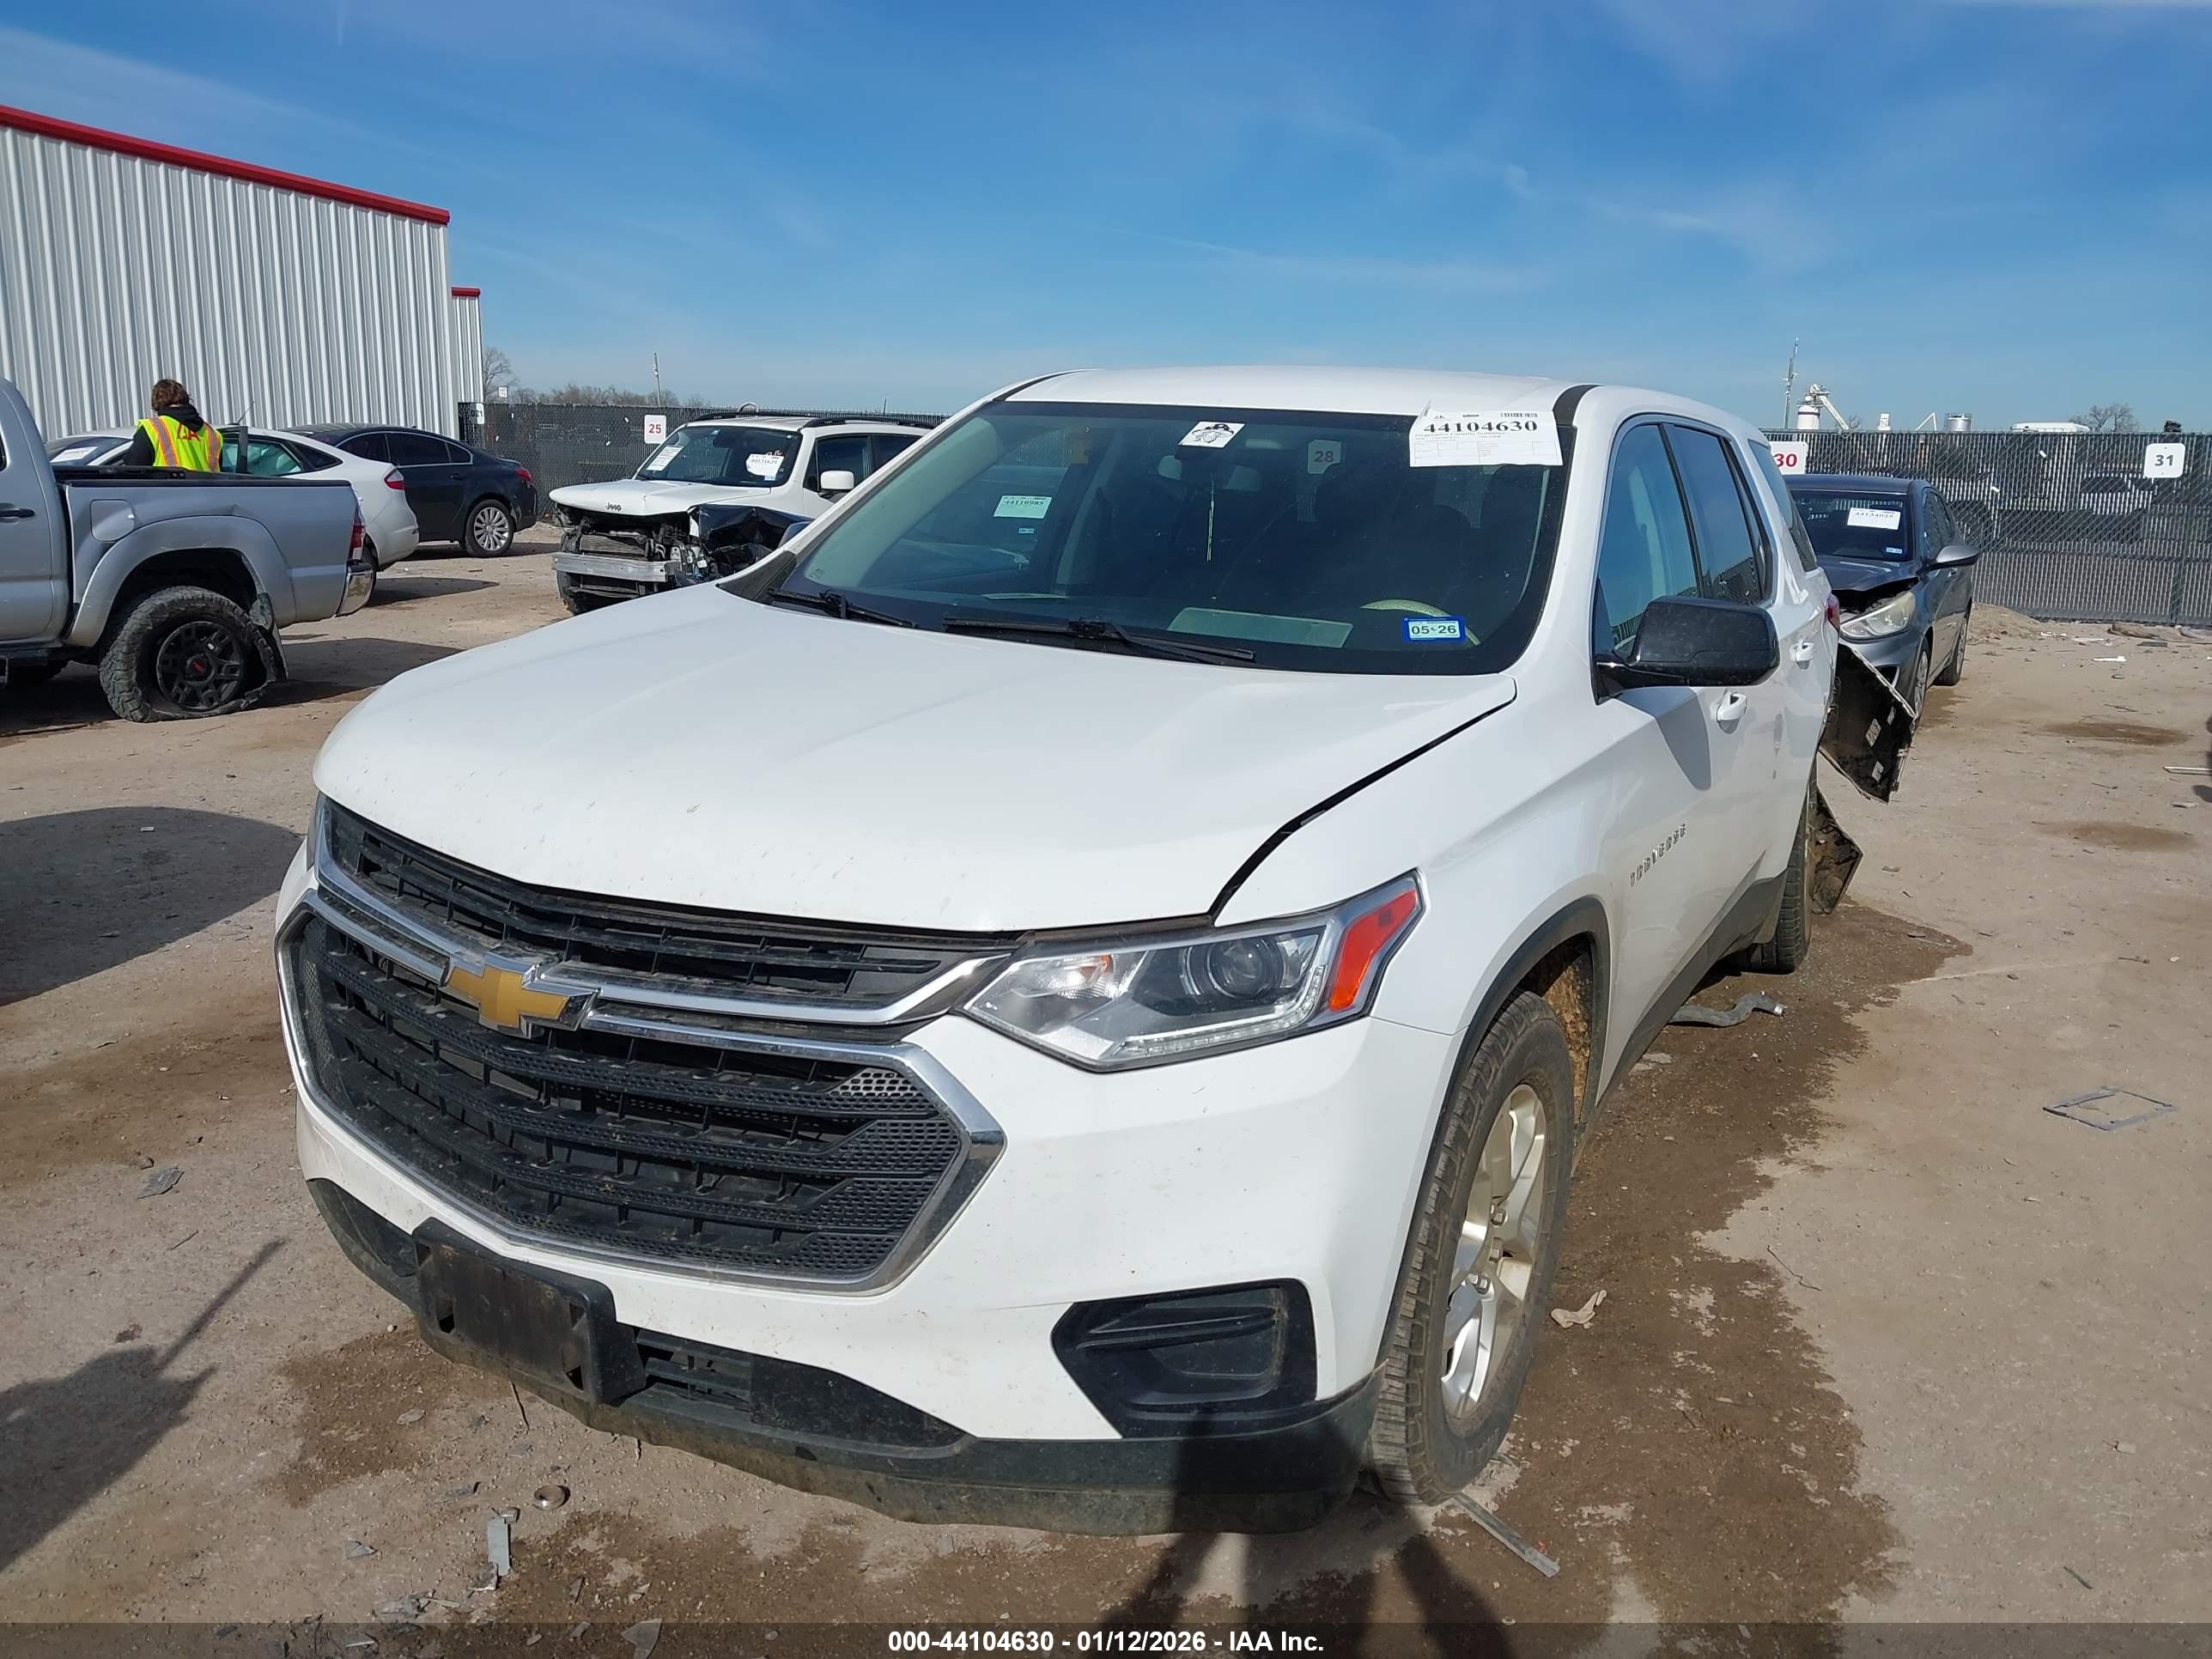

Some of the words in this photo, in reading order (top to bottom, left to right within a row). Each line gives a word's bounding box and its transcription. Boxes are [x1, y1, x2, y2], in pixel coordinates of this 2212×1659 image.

[648, 423, 662, 434] 25
[1424, 420, 1538, 433] 44104630
[1314, 450, 1334, 463] 28
[1774, 453, 1798, 467] 30
[2154, 454, 2174, 466] 31
[605, 502, 622, 512] Jeep
